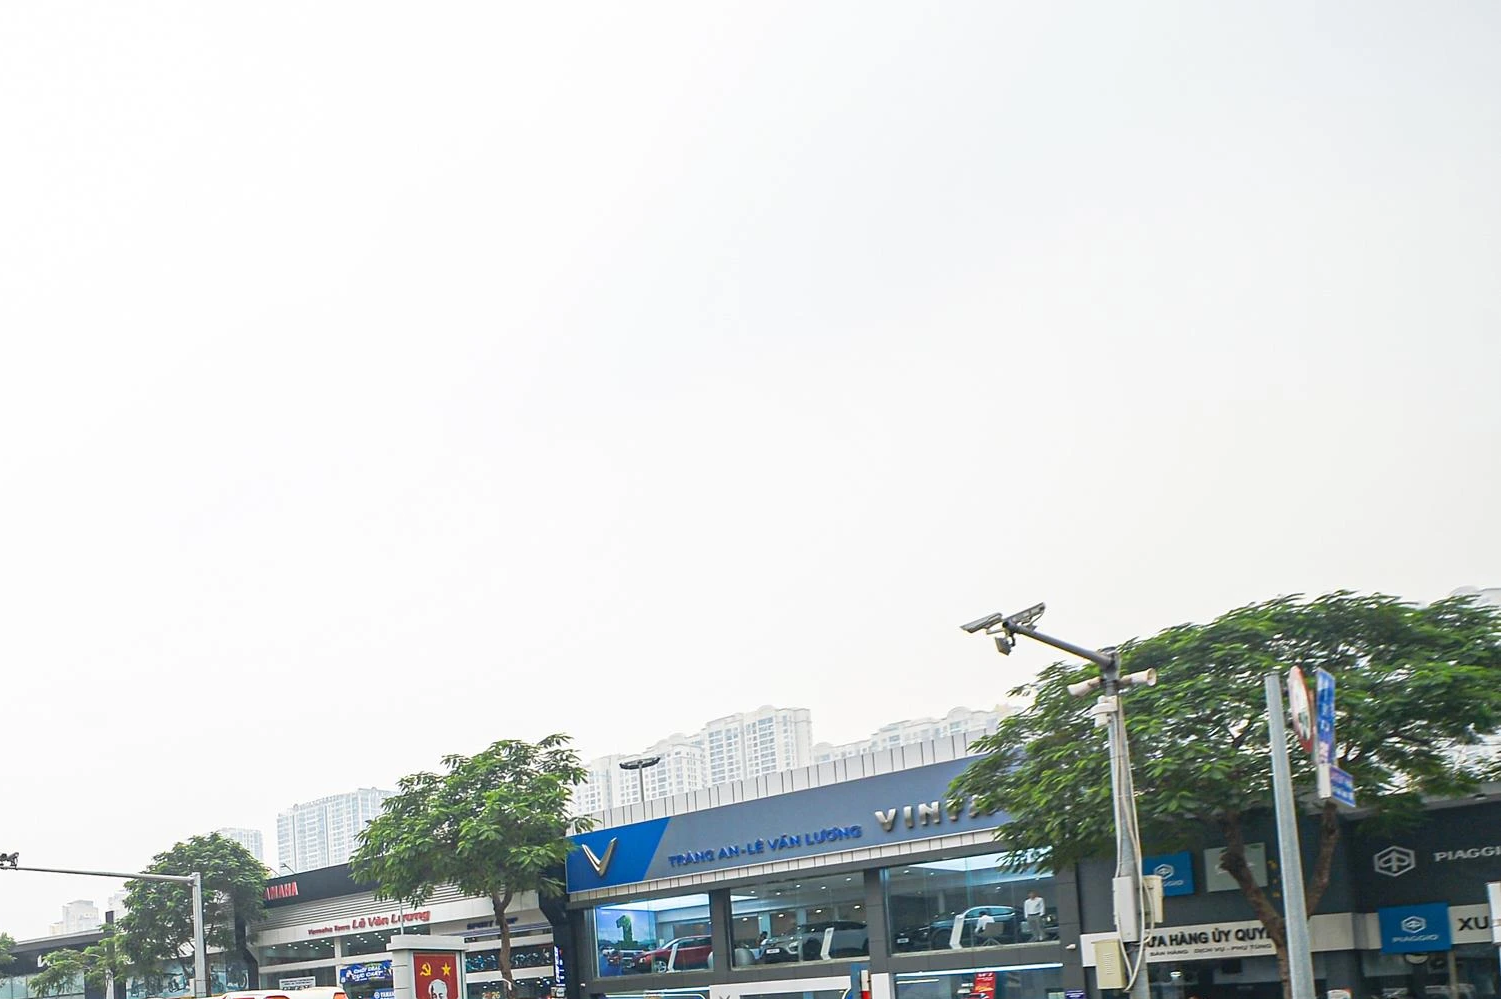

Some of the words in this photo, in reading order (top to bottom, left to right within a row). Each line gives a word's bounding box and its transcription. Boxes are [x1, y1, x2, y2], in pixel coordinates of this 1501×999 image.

[1434, 845, 1501, 862] PIAGGI
[1169, 930, 1209, 946] HÀNG
[1212, 927, 1231, 943] ỦY
[1235, 926, 1272, 942] QUY
